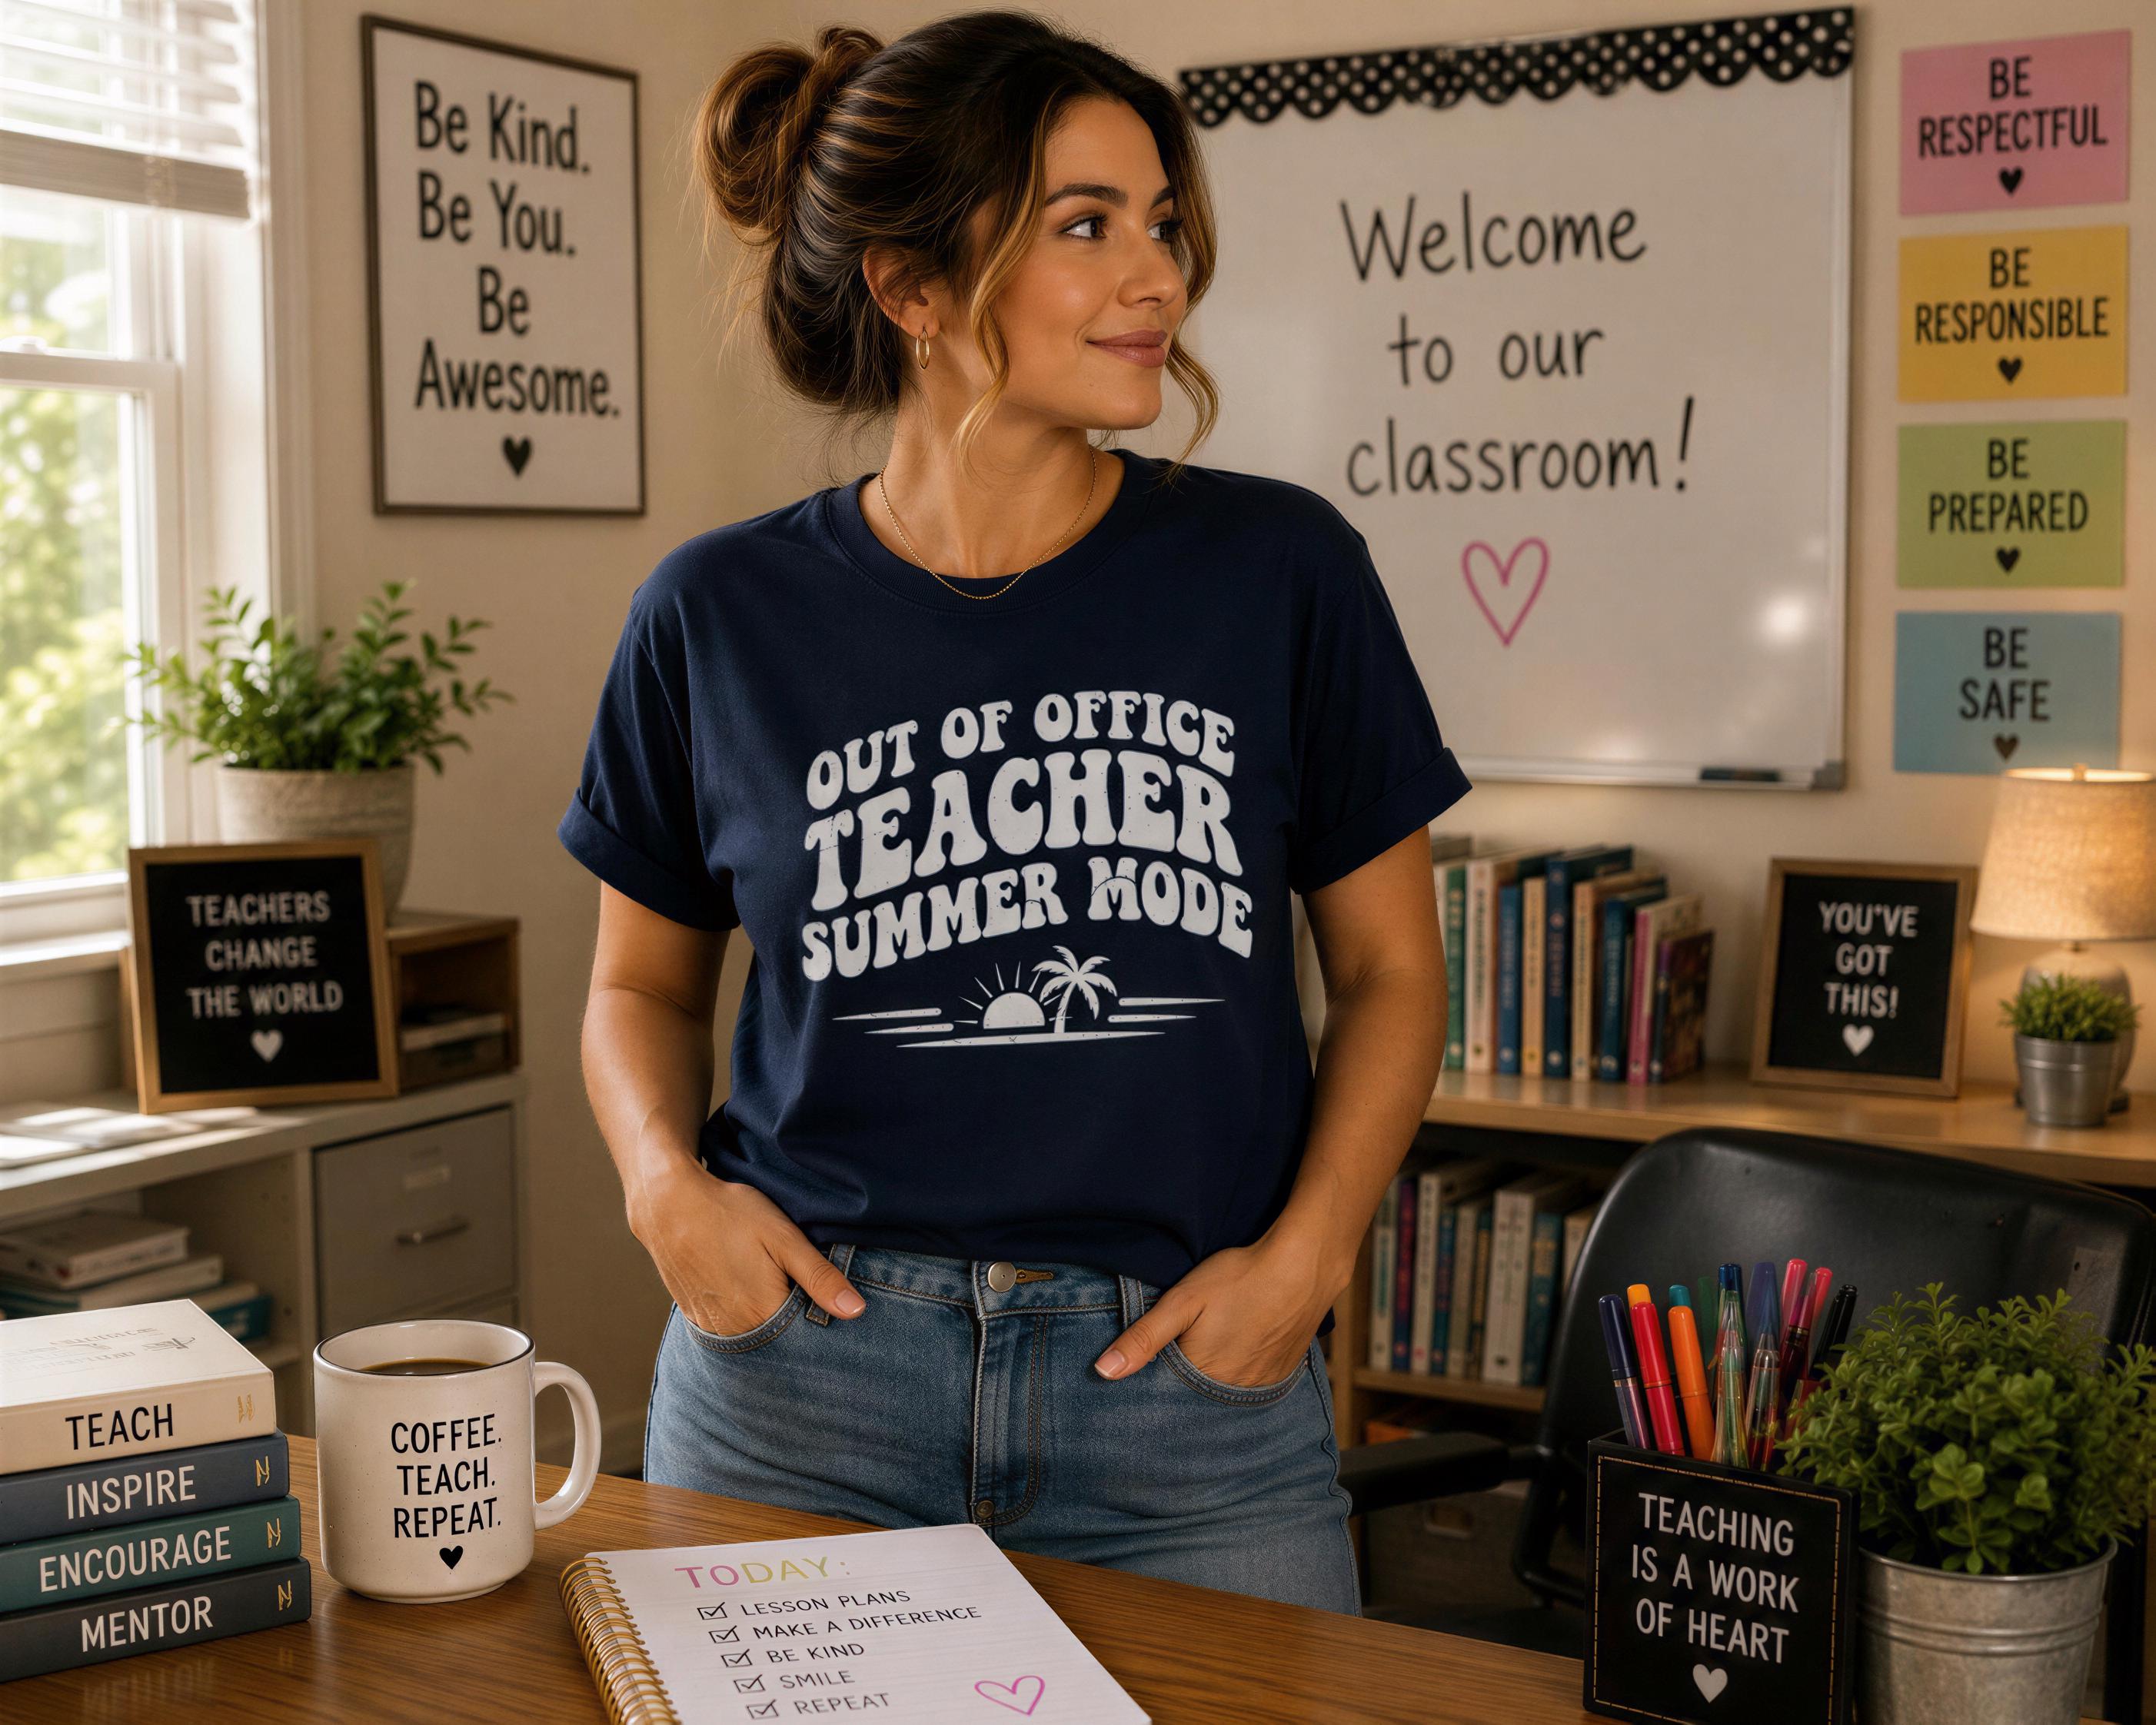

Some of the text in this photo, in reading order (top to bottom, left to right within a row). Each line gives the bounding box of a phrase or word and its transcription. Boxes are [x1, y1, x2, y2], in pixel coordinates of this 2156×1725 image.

[1989, 56, 2032, 100] BE
[415, 80, 591, 174] Be Kind.
[1918, 105, 2108, 159] RESPECTFUL
[420, 171, 577, 257] Be You.
[1340, 190, 1647, 282] Welcome
[1989, 248, 2031, 289] BE
[478, 267, 530, 334] Be
[1916, 296, 2109, 344] RESPONSIBLE
[1388, 313, 1604, 387] to our
[415, 340, 620, 418] Awesome.
[1346, 395, 1694, 496] classroom!
[1988, 438, 2030, 480] BE
[1929, 491, 2089, 533] PREPARED
[1985, 627, 2028, 668] BE
[1960, 680, 2051, 722] SAFE
[806, 690, 1235, 810] OUT OF OFFICE
[804, 749, 1243, 912] TEACHER
[187, 891, 331, 927] TEACHERS
[801, 857, 1253, 981] SUMMER MODE
[1818, 902, 1919, 938] YOU'VE
[205, 936, 318, 969] CHANGE
[1835, 943, 1893, 976] GOT
[187, 981, 343, 1019] THE WORLD
[1824, 982, 1899, 1019] THIS!
[65, 1403, 174, 1451] TEACH
[391, 1412, 502, 1454] COFFEE.
[66, 1465, 197, 1520] INSPIRE
[396, 1457, 496, 1496] TEACH.
[394, 1497, 501, 1538] REPEAT.
[1638, 1492, 1794, 1557] TEACHING
[39, 1525, 231, 1593] ENCOURAGE
[1632, 1544, 1799, 1614] IS A WORK
[80, 1596, 213, 1653] MENTOR
[740, 1590, 911, 1617] LESSON PLANS
[753, 1607, 982, 1640] MAKE A DIFFERENCE
[1635, 1597, 1789, 1663] OF HEART
[767, 1643, 864, 1664] BE KIND
[779, 1670, 855, 1690] SMILE
[794, 1692, 891, 1715] REPEAT
